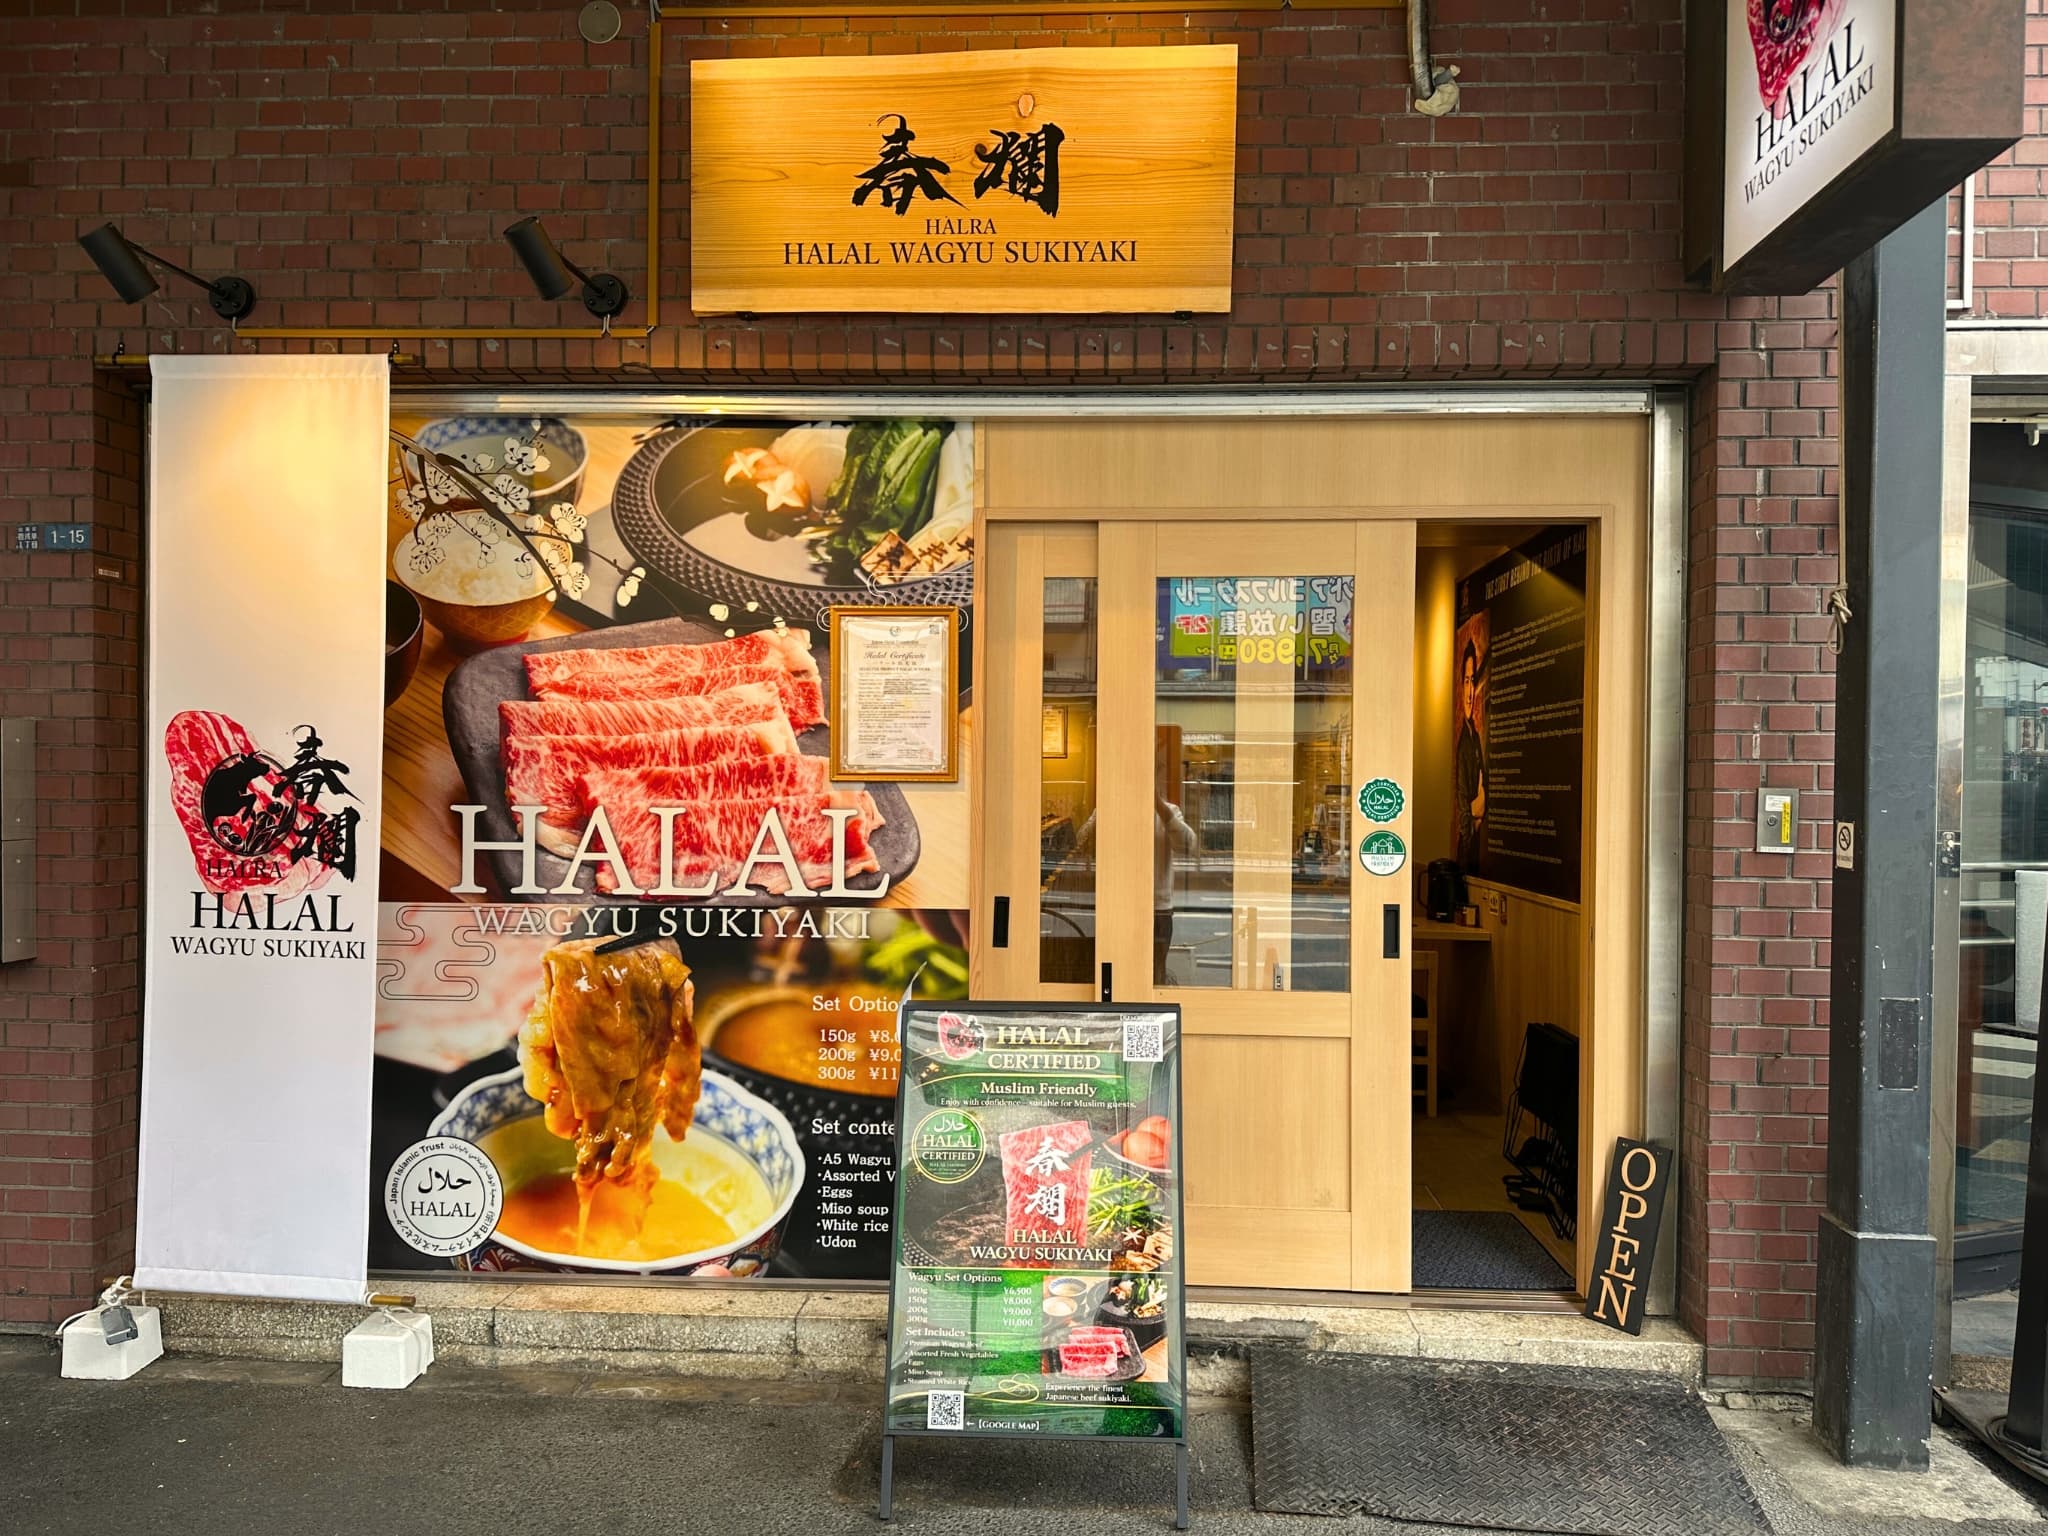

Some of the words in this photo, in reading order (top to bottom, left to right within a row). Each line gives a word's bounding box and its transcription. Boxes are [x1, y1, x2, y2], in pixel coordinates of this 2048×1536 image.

[1754, 17, 1865, 166] HALAL
[1744, 144, 1795, 204] WAGYU
[1799, 64, 1875, 155] SUKIYAKI
[925, 218, 997, 236] HALRA
[783, 242, 880, 265] HALAL
[892, 242, 994, 264] WAGYU
[1005, 240, 1137, 263] SUKIYAKI
[51, 530, 85, 544] 1-15
[1369, 792, 1393, 805] حلال
[449, 804, 890, 899] HALAL
[190, 891, 354, 932] HALAL
[471, 906, 640, 938] WAGYU
[658, 906, 871, 940] SUKIYAKI
[171, 936, 256, 956] WAGYU
[263, 939, 366, 959] SUKIYAKI
[812, 995, 841, 1012] Set
[849, 995, 901, 1013] Optio
[820, 1028, 857, 1044] 150g
[996, 1026, 1090, 1046] HALAL
[818, 1048, 857, 1063] 200g
[988, 1054, 1101, 1071] CERTIFIED
[818, 1066, 856, 1081] 300g
[980, 1082, 1035, 1095] Muslim
[1038, 1082, 1098, 1097] Friendly
[940, 1098, 961, 1107] Enjoy
[962, 1098, 980, 1107] with
[980, 1098, 1022, 1107] confidence
[1028, 1099, 1059, 1107] suitable
[1060, 1099, 1073, 1108] for
[1074, 1099, 1106, 1108] Muslim
[812, 1118, 841, 1135] Set
[933, 1116, 969, 1133] حلال
[922, 1134, 977, 1148] HALAL
[823, 1154, 842, 1165] A5
[847, 1153, 891, 1166] Wagyu
[922, 1151, 976, 1161] CERTIFIED
[389, 1177, 400, 1204] Japan
[397, 1151, 420, 1177] Islamic
[419, 1142, 445, 1154] Trust
[417, 1166, 472, 1194] حلال
[822, 1170, 880, 1182] Assorted
[822, 1187, 853, 1199] Eggs
[410, 1201, 477, 1218] HALAL
[821, 1203, 852, 1215] Miso
[857, 1205, 889, 1217] soup
[821, 1219, 858, 1232] White
[864, 1220, 889, 1232] rice
[820, 1235, 857, 1248] Udon
[1013, 1229, 1077, 1245] HALAL
[1593, 1147, 1657, 1327] OPEN
[970, 1246, 1032, 1261] WAGYU
[1034, 1247, 1113, 1262] SUKIYAKI
[908, 1271, 942, 1282] Wagyu
[944, 1272, 960, 1282] Set
[963, 1273, 1003, 1284] Options
[907, 1296, 928, 1304] 150g
[906, 1306, 928, 1314] 200g
[905, 1327, 921, 1337] Set
[924, 1327, 966, 1337] Includes
[960, 1351, 999, 1359] Vegetables
[907, 1368, 925, 1376] Miso
[925, 1369, 944, 1377] Soup
[1045, 1383, 1086, 1392] Experience
[1088, 1384, 1101, 1392] the
[1102, 1384, 1124, 1393] finest
[1045, 1392, 1080, 1401] Japanese
[1080, 1393, 1098, 1402] beef
[1098, 1394, 1132, 1403] sukiyaki.
